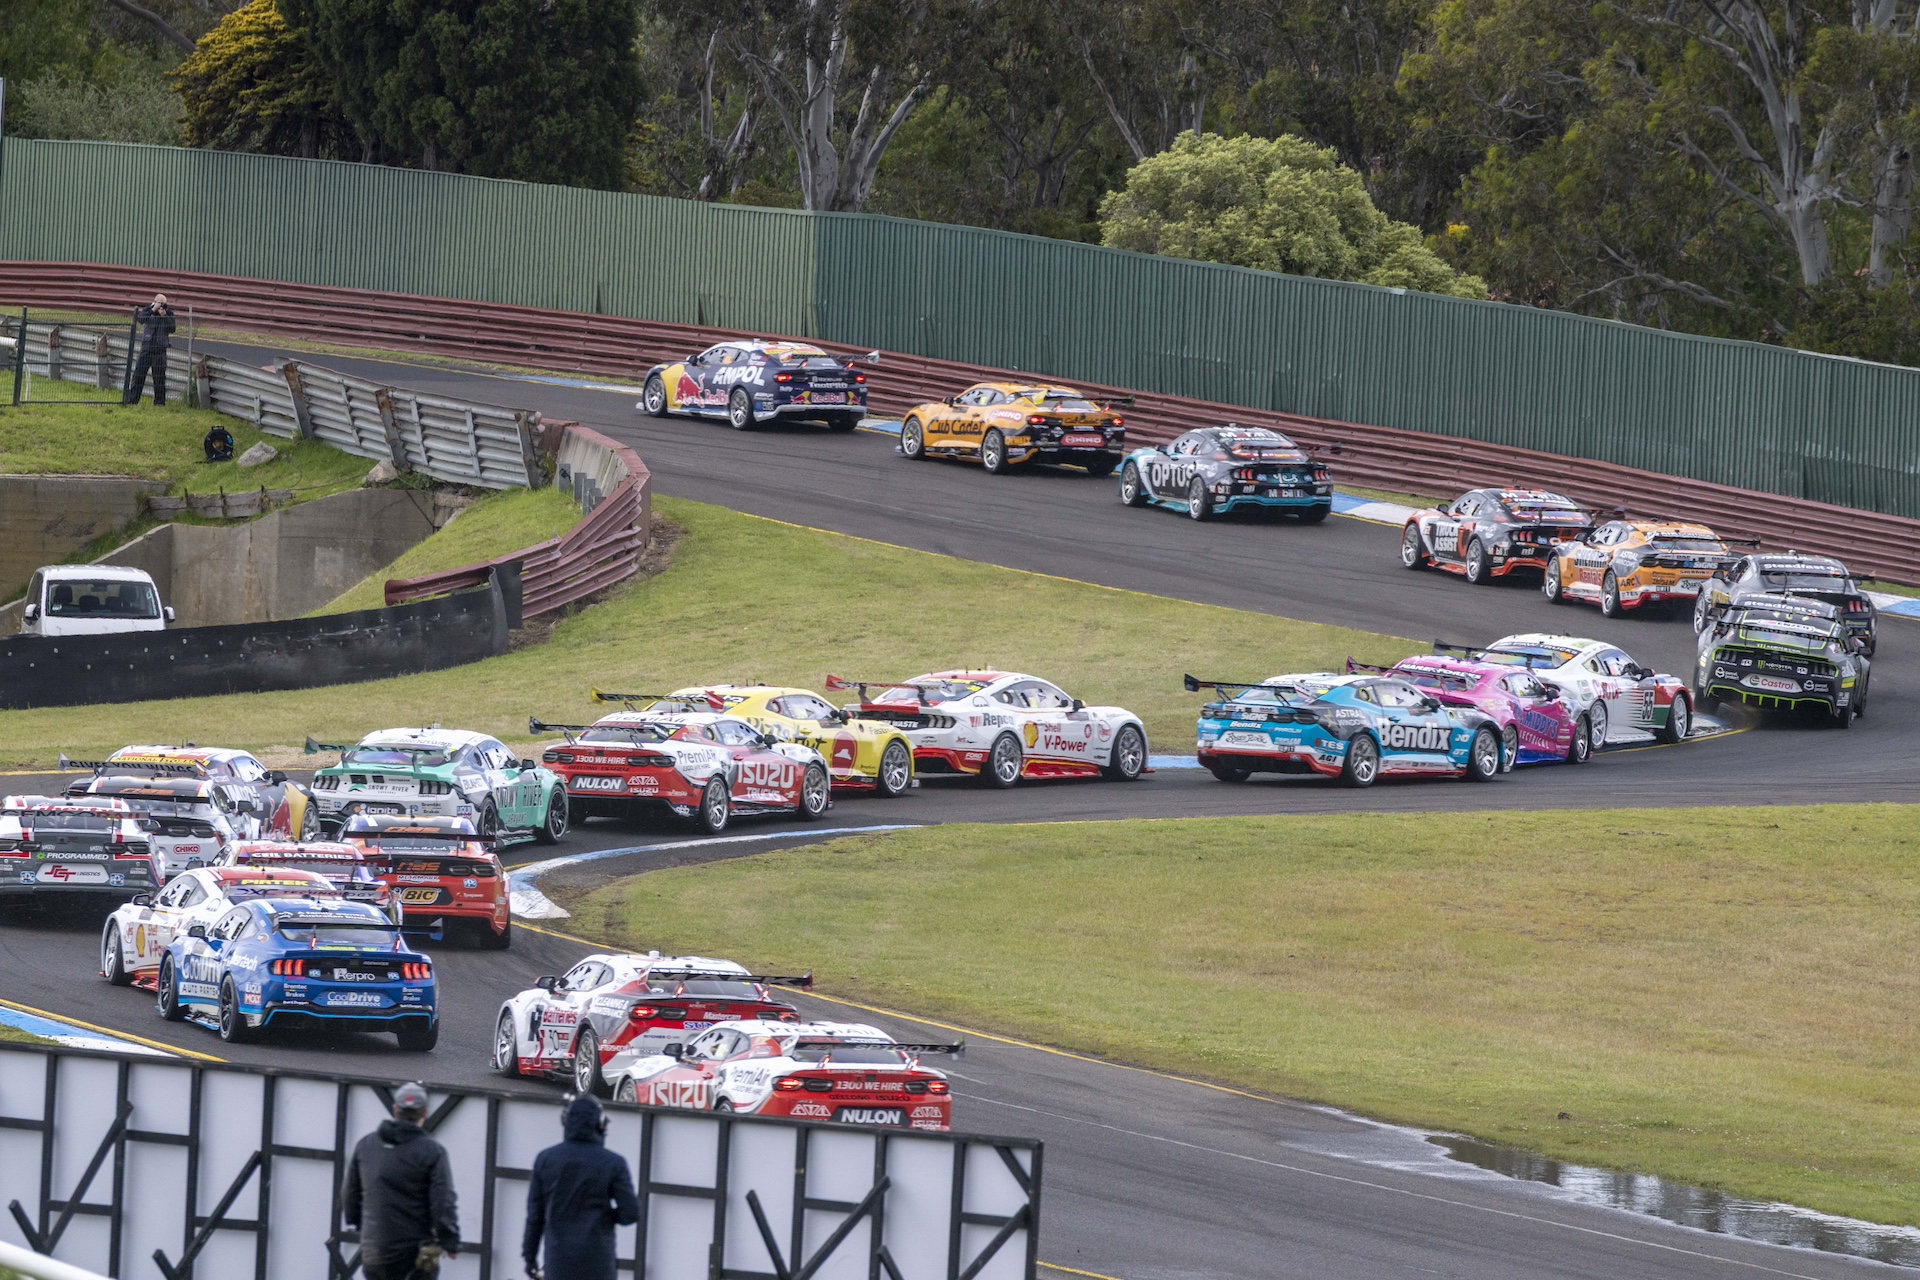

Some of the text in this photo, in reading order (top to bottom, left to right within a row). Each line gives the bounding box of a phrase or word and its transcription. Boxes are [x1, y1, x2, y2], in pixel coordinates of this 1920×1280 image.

[712, 366, 765, 386] AMPOL
[926, 417, 985, 434] Cub Cadet
[1268, 489, 1294, 498] Mobil
[1434, 537, 1458, 552] ASSIST
[1760, 678, 1794, 690] Castrol
[1641, 690, 1655, 720] 55
[981, 713, 1015, 728] Repco
[1044, 721, 1061, 733] Shell
[1229, 721, 1263, 729] Bendix
[1375, 717, 1452, 751] Bendix
[1044, 735, 1087, 753] V-Power
[1321, 740, 1344, 750] TES
[607, 756, 626, 765] HIRE
[737, 761, 794, 788] ISUZU
[576, 777, 622, 790] NULON
[522, 784, 544, 807] RIVER
[745, 786, 780, 800] TRUCKS
[46, 852, 109, 860] PROGRAMMED
[333, 967, 376, 982] Aerpro
[181, 984, 216, 997] AUTO PARTS
[327, 991, 381, 1002] CoolDrive
[244, 993, 262, 1005] MOLY
[542, 1007, 577, 1025] Batteries
[703, 1011, 742, 1021] Mastercam
[836, 1080, 904, 1091] 1300 WE HIRE
[649, 1078, 711, 1109] ISUZU
[841, 1109, 902, 1124] NULON
[912, 1119, 942, 1127] ISUZU
